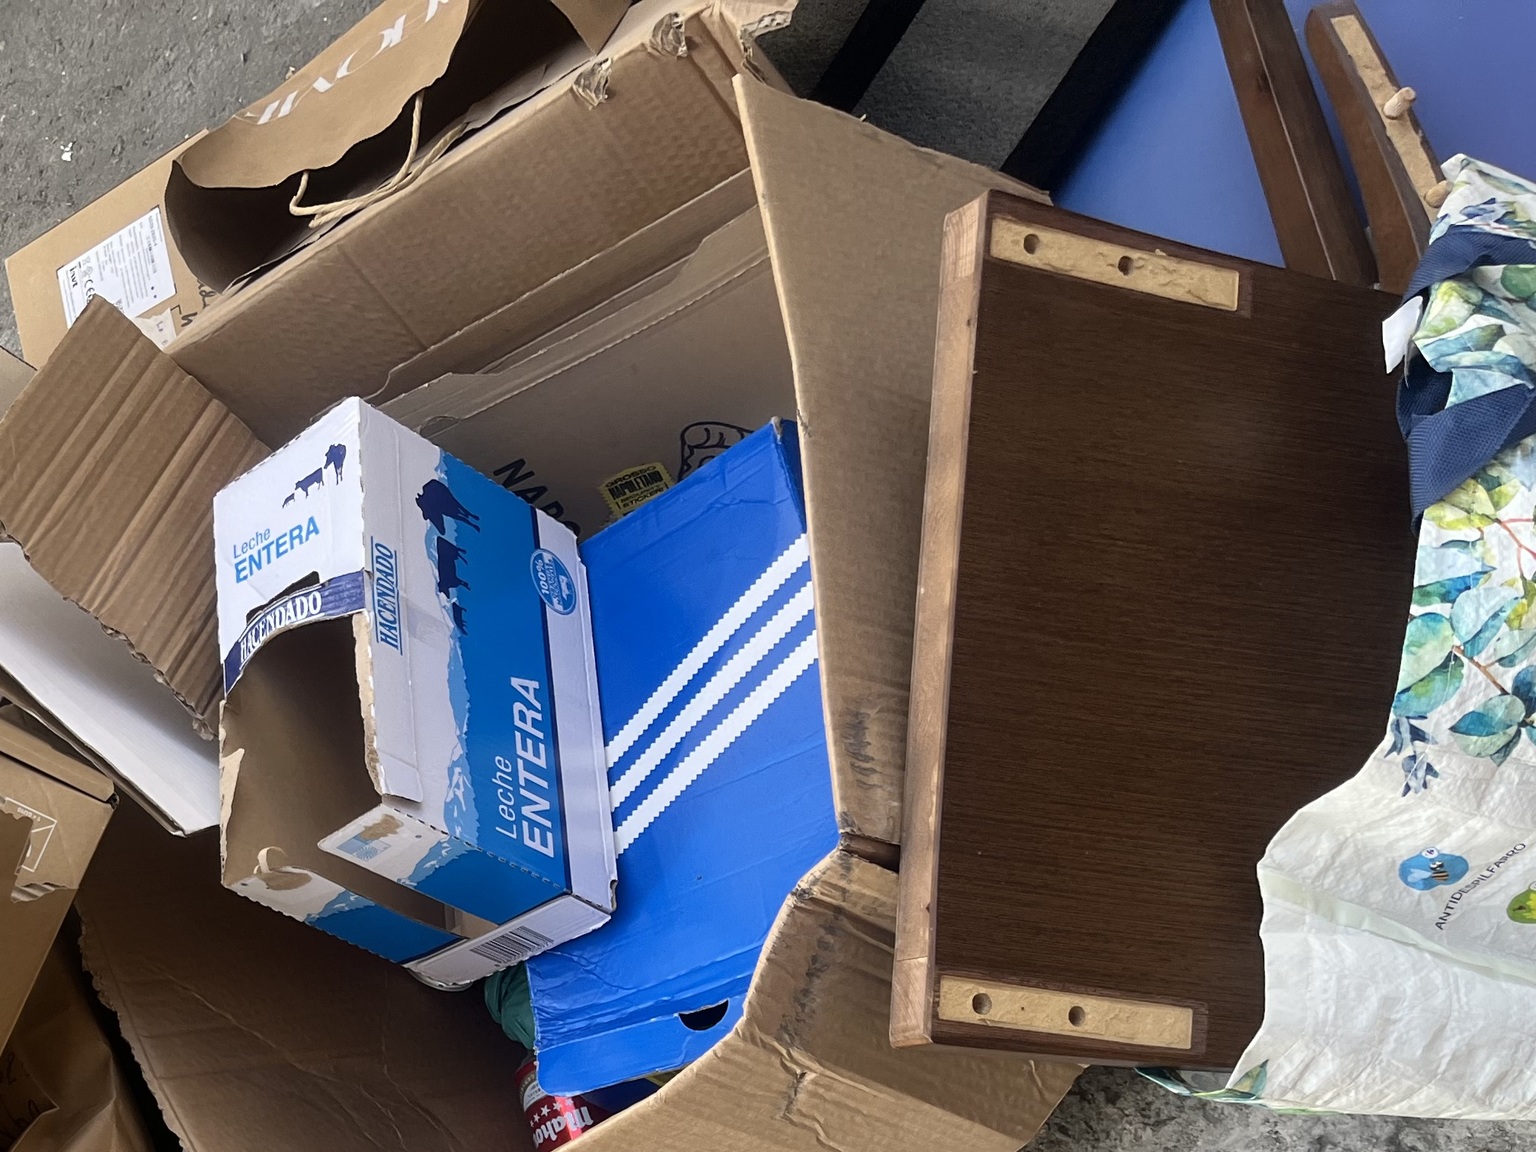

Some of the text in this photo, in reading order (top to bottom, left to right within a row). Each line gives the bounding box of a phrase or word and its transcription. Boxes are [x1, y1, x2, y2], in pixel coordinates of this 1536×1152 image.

[605, 465, 657, 488] GROSSO
[233, 528, 271, 559] Leche
[234, 516, 320, 584] ENTERA
[534, 558, 550, 595] 100%
[240, 591, 322, 664] HACENDADO
[375, 543, 400, 650] HACENDADO
[491, 756, 517, 840] Leche
[510, 676, 555, 859] ENTERA
